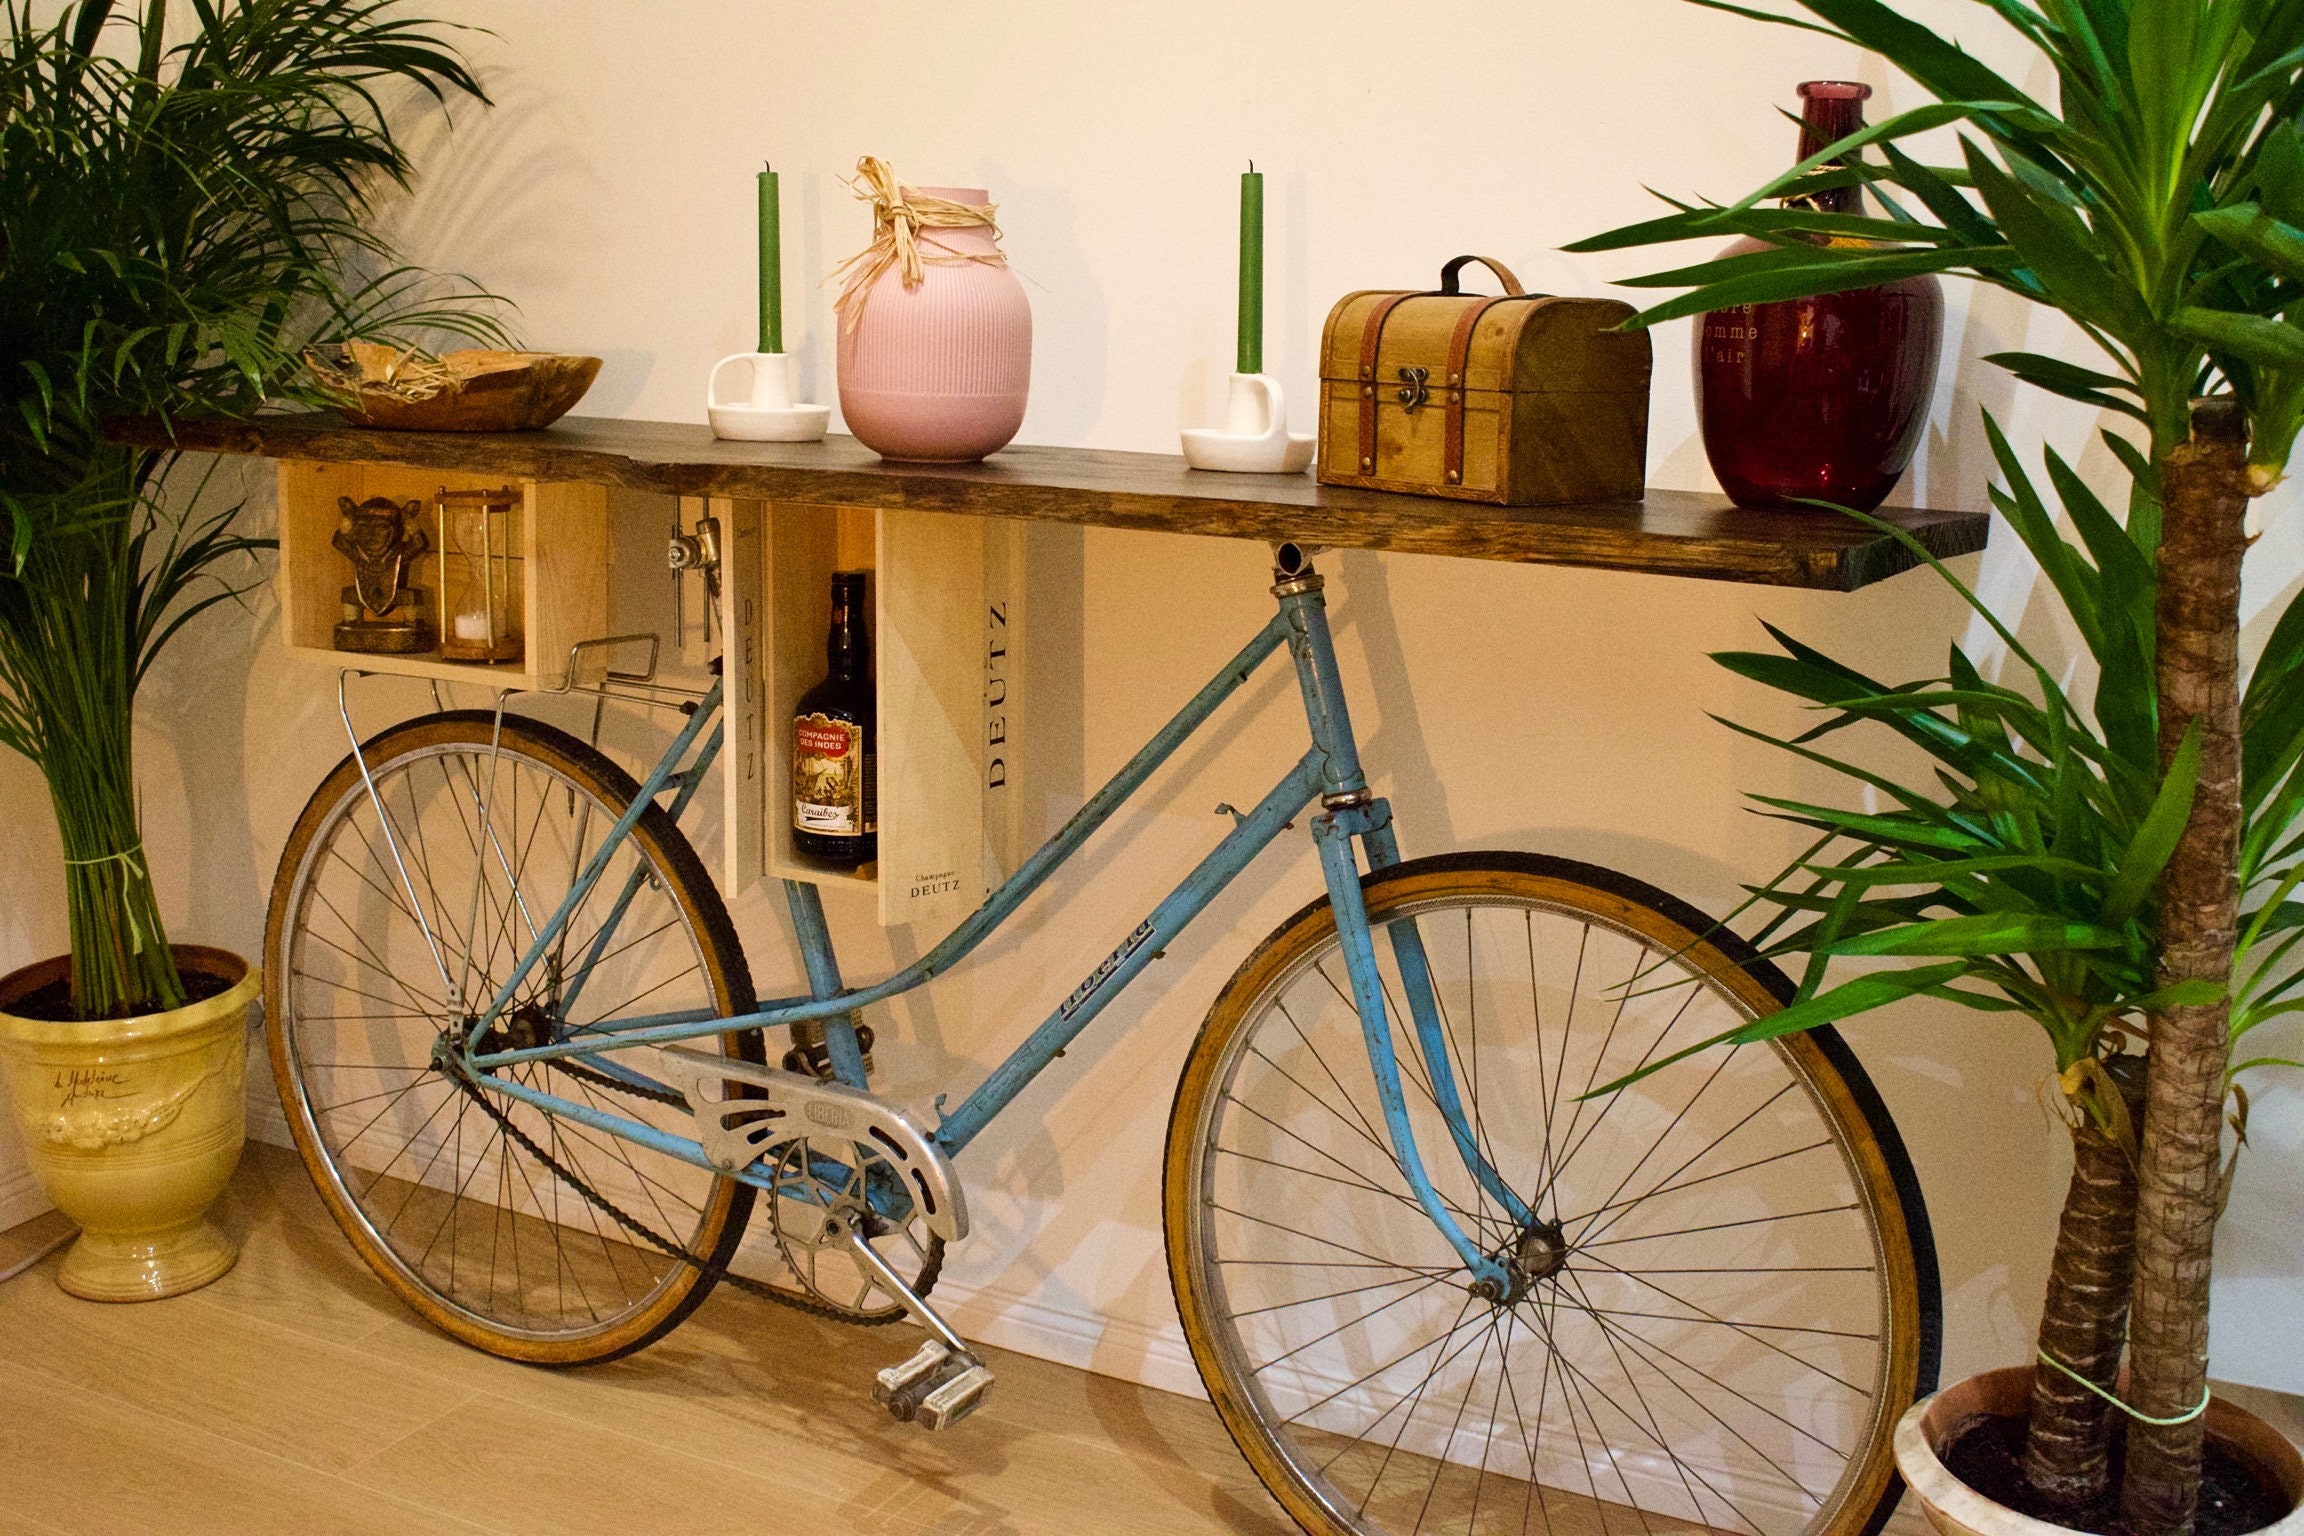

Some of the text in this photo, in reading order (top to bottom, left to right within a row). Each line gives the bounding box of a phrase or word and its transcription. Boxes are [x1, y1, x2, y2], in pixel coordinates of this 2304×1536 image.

[744, 599, 754, 780] DEUTZ
[989, 601, 1007, 789] DEUTZ
[798, 729, 846, 742] COMPAGNIE
[800, 738, 842, 750] DES INDES
[911, 879, 960, 898] DEUTZ
